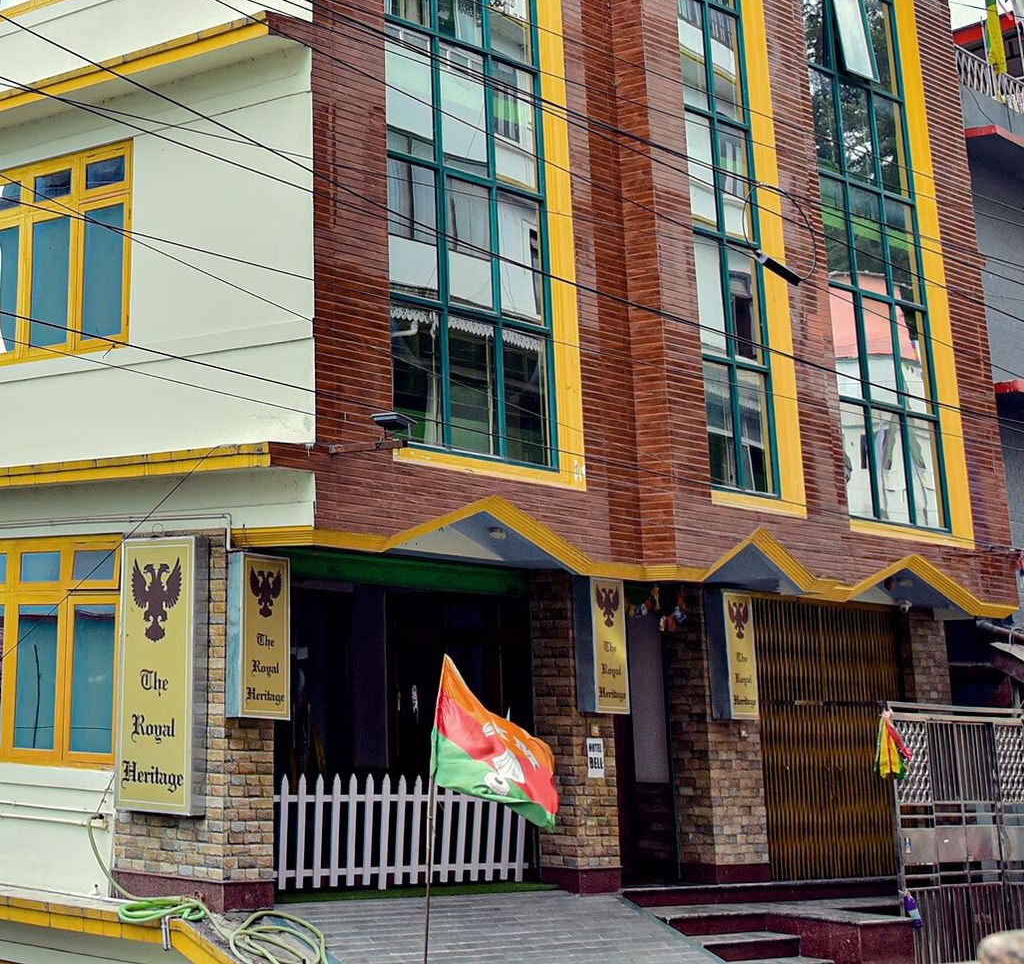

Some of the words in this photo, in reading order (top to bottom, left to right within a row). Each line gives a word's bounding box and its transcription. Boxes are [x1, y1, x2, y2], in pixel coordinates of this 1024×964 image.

[256, 633, 275, 650] The
[603, 640, 617, 655] The
[251, 659, 280, 677] Royal
[600, 663, 622, 679] Royal
[140, 669, 169, 696] The
[246, 687, 285, 706] Heritage
[598, 686, 626, 703] Heritage
[131, 714, 175, 744] Royal
[589, 757, 604, 770] BELL
[122, 760, 184, 793] Heritage
